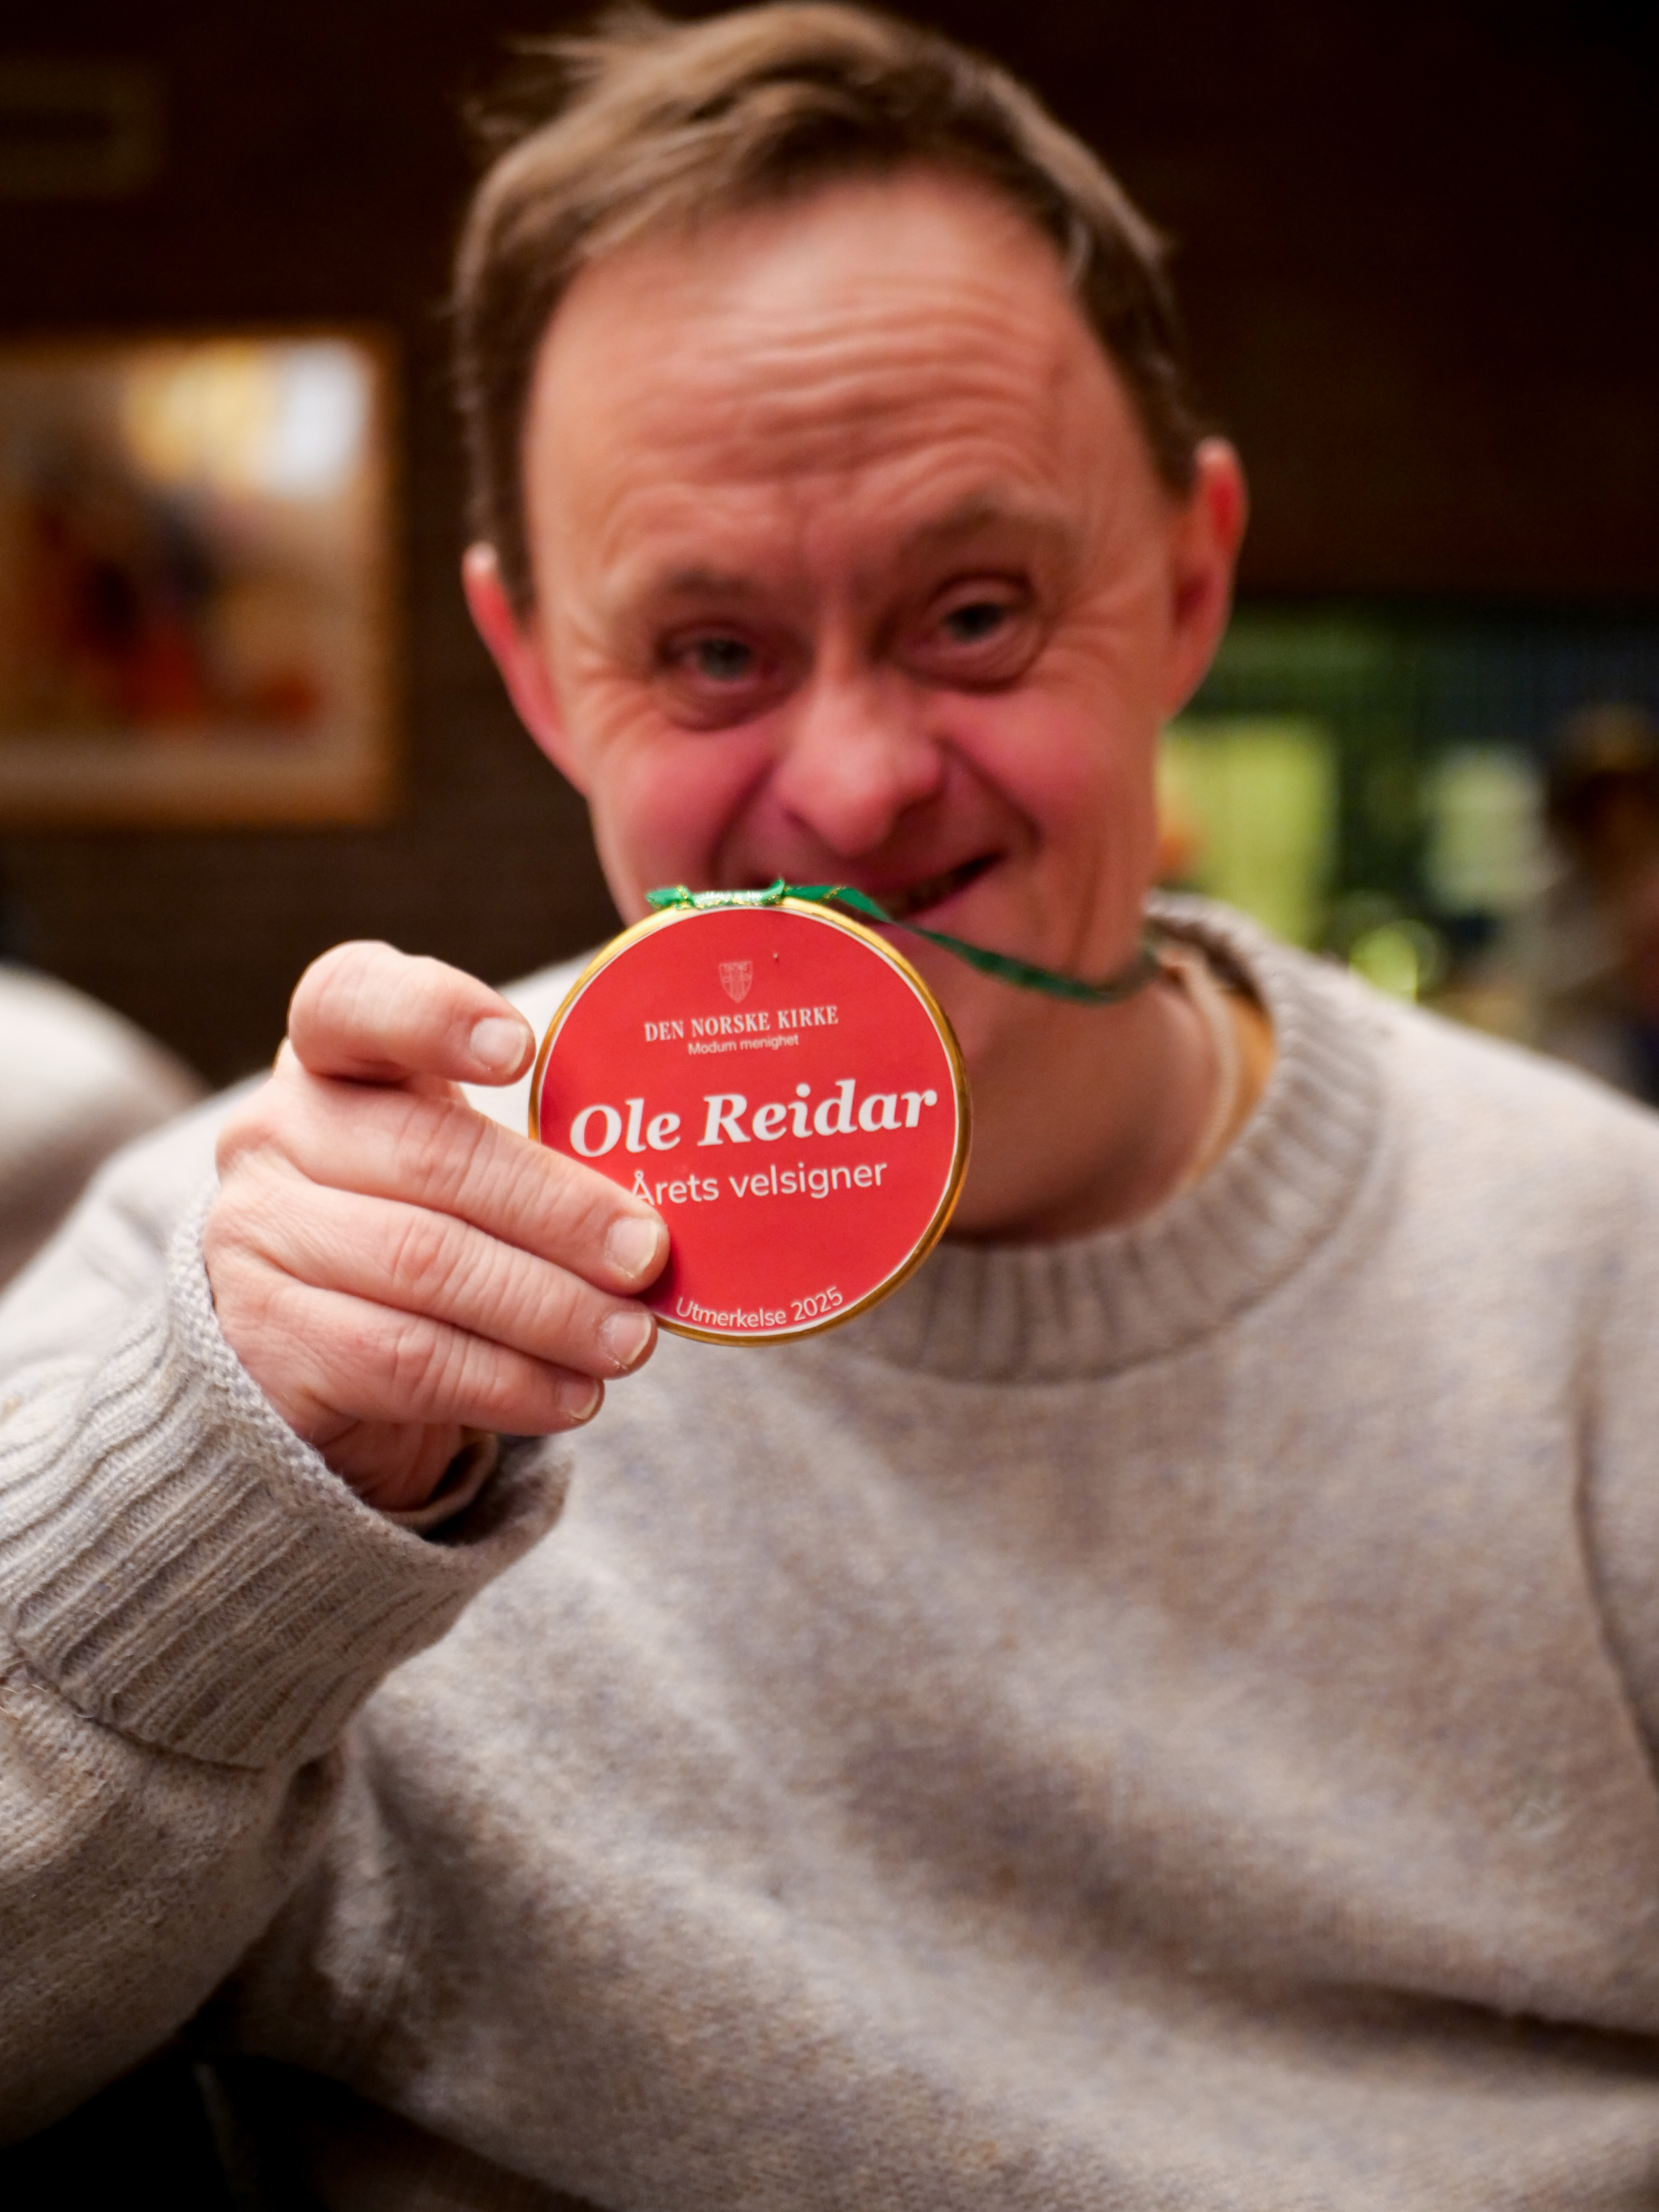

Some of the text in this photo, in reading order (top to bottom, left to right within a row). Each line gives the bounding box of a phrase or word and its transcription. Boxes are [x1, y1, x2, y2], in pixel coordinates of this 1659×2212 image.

[644, 1006, 839, 1042] DEN NORSKE KIRKE
[688, 1034, 799, 1055] Modum menighet
[570, 1078, 938, 1158] Ole Reidar
[632, 1162, 888, 1206] Årets velsigner
[675, 1286, 844, 1328] Utmerkelse 2025
